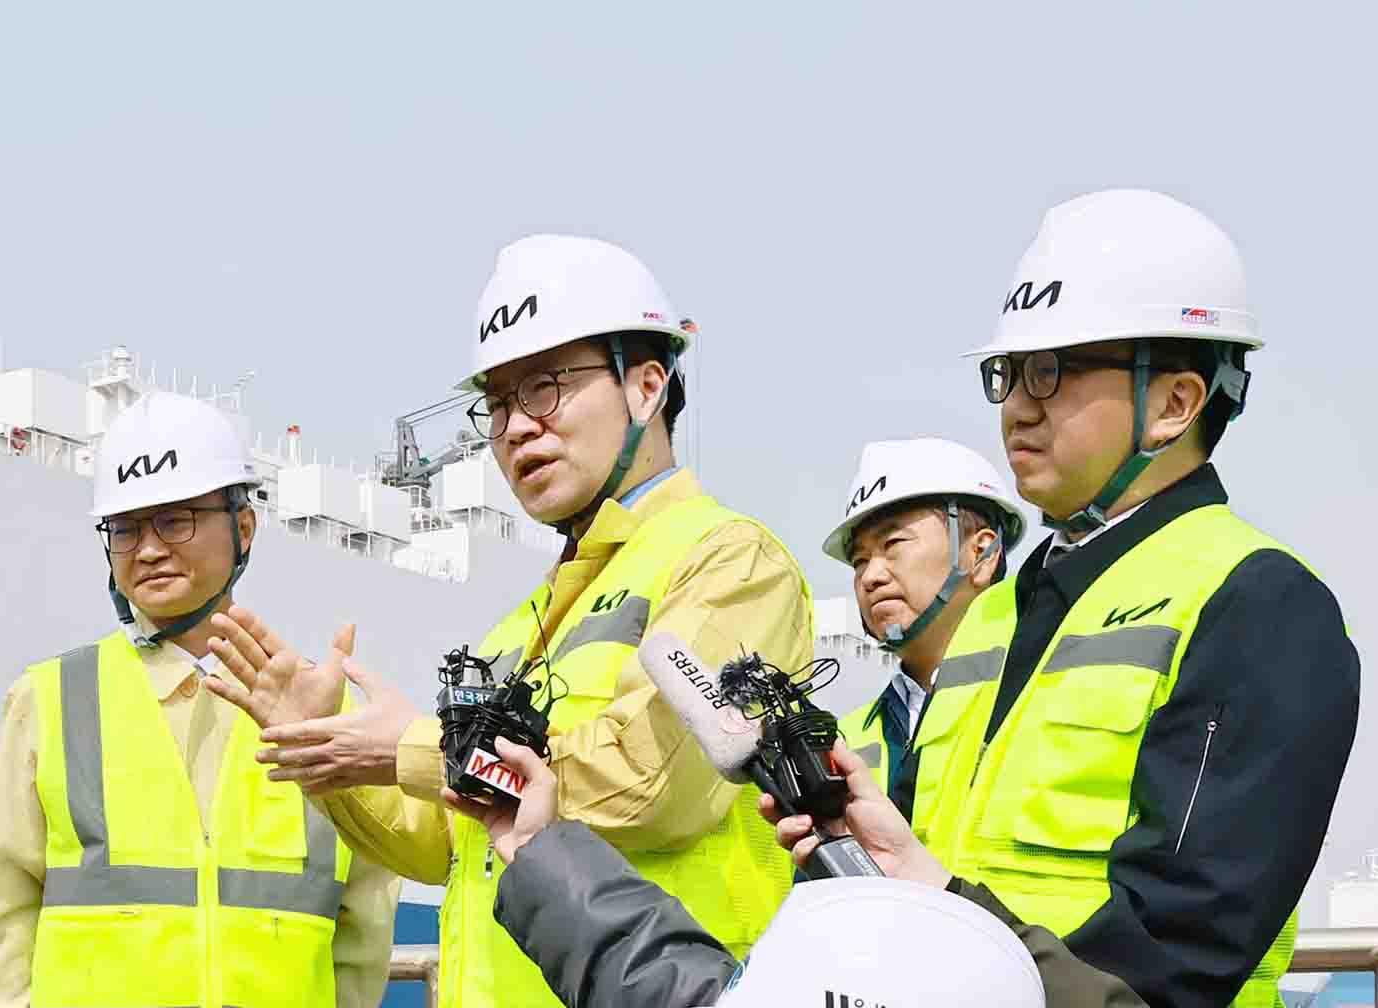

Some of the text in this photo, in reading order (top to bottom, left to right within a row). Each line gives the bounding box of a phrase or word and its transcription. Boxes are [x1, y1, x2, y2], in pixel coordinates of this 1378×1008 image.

[1002, 280, 1062, 315] KIA
[480, 294, 537, 344] KIA
[118, 449, 178, 484] KIA
[668, 650, 730, 710] REUTERS
[471, 753, 527, 794] MTN
